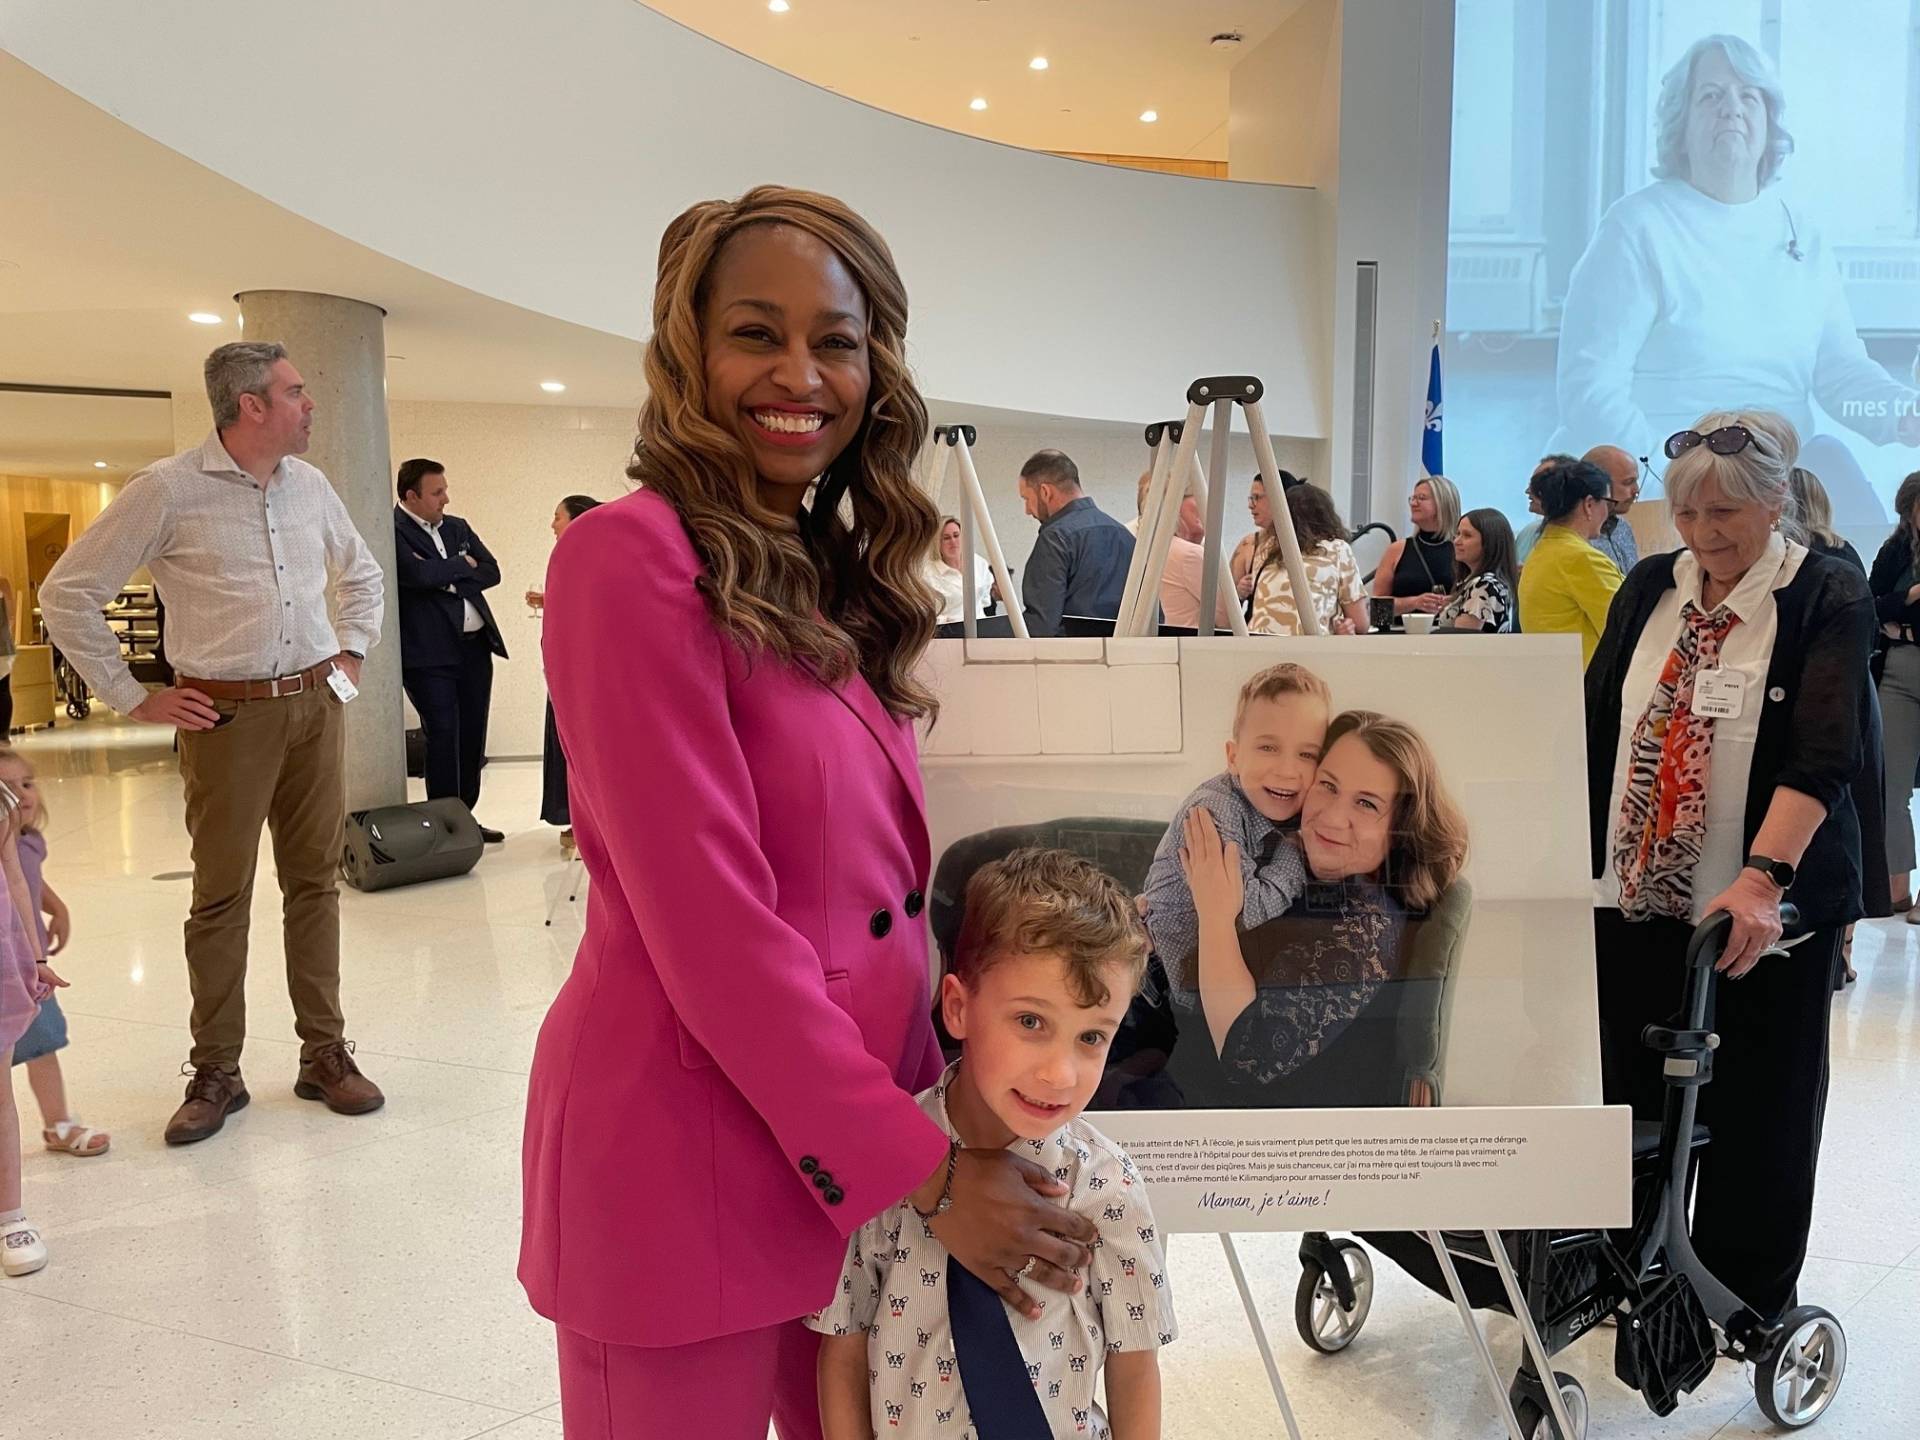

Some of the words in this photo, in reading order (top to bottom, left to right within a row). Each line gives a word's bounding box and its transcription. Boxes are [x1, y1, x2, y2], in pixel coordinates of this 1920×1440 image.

[1842, 400, 1887, 417] mes
[1121, 1139, 1128, 1148] je
[1130, 1140, 1145, 1148] suis
[1146, 1139, 1172, 1148] atteint
[1173, 1139, 1183, 1147] de
[1202, 1137, 1208, 1146] À
[1209, 1138, 1235, 1147] l'école,
[1236, 1139, 1244, 1148] je
[1261, 1138, 1296, 1146] vraiment
[1297, 1138, 1314, 1147] plus
[1315, 1138, 1334, 1147] petit
[1334, 1138, 1350, 1147] que
[1351, 1137, 1363, 1145] les
[1389, 1137, 1408, 1145] amis
[1409, 1137, 1419, 1145] de
[1434, 1136, 1458, 1144] classe
[1469, 1137, 1478, 1145] ça
[1494, 1136, 1528, 1145] dérange.
[1166, 1151, 1193, 1159] rendre
[1193, 1151, 1199, 1159] à
[1199, 1151, 1231, 1160] l'hôpital
[1231, 1152, 1250, 1160] pour
[1251, 1150, 1266, 1158] des
[1298, 1150, 1330, 1158] prendre
[1331, 1149, 1345, 1157] des
[1346, 1149, 1373, 1157] photos
[1418, 1148, 1428, 1156] Je
[1429, 1148, 1454, 1156] n'aime
[1455, 1149, 1470, 1157] pas
[1470, 1148, 1506, 1156] vraiment
[1506, 1148, 1518, 1157] ça.
[1136, 1164, 1154, 1172] oins,
[1155, 1163, 1173, 1171] c'est
[1174, 1163, 1199, 1171] d'avoir
[1216, 1162, 1246, 1171] piqûres.
[1248, 1162, 1267, 1170] Mais
[1268, 1162, 1275, 1171] je
[1276, 1162, 1291, 1170] suis
[1292, 1162, 1332, 1170] chanceux,
[1346, 1161, 1357, 1170] j'ai
[1372, 1160, 1393, 1168] mère
[1394, 1161, 1407, 1169] qui
[1421, 1160, 1453, 1169] toujours
[1143, 1175, 1155, 1184] ée,
[1156, 1175, 1170, 1183] elle
[1204, 1174, 1229, 1182] monté
[1239, 1173, 1287, 1182] Kilimandjaro
[1288, 1174, 1307, 1182] pour
[1358, 1172, 1380, 1180] fonds
[1381, 1173, 1400, 1181] pour
[1401, 1172, 1408, 1180] la
[1198, 1192, 1255, 1211] Maman,
[1256, 1193, 1275, 1216] je
[1568, 1295, 1616, 1337] Stella
